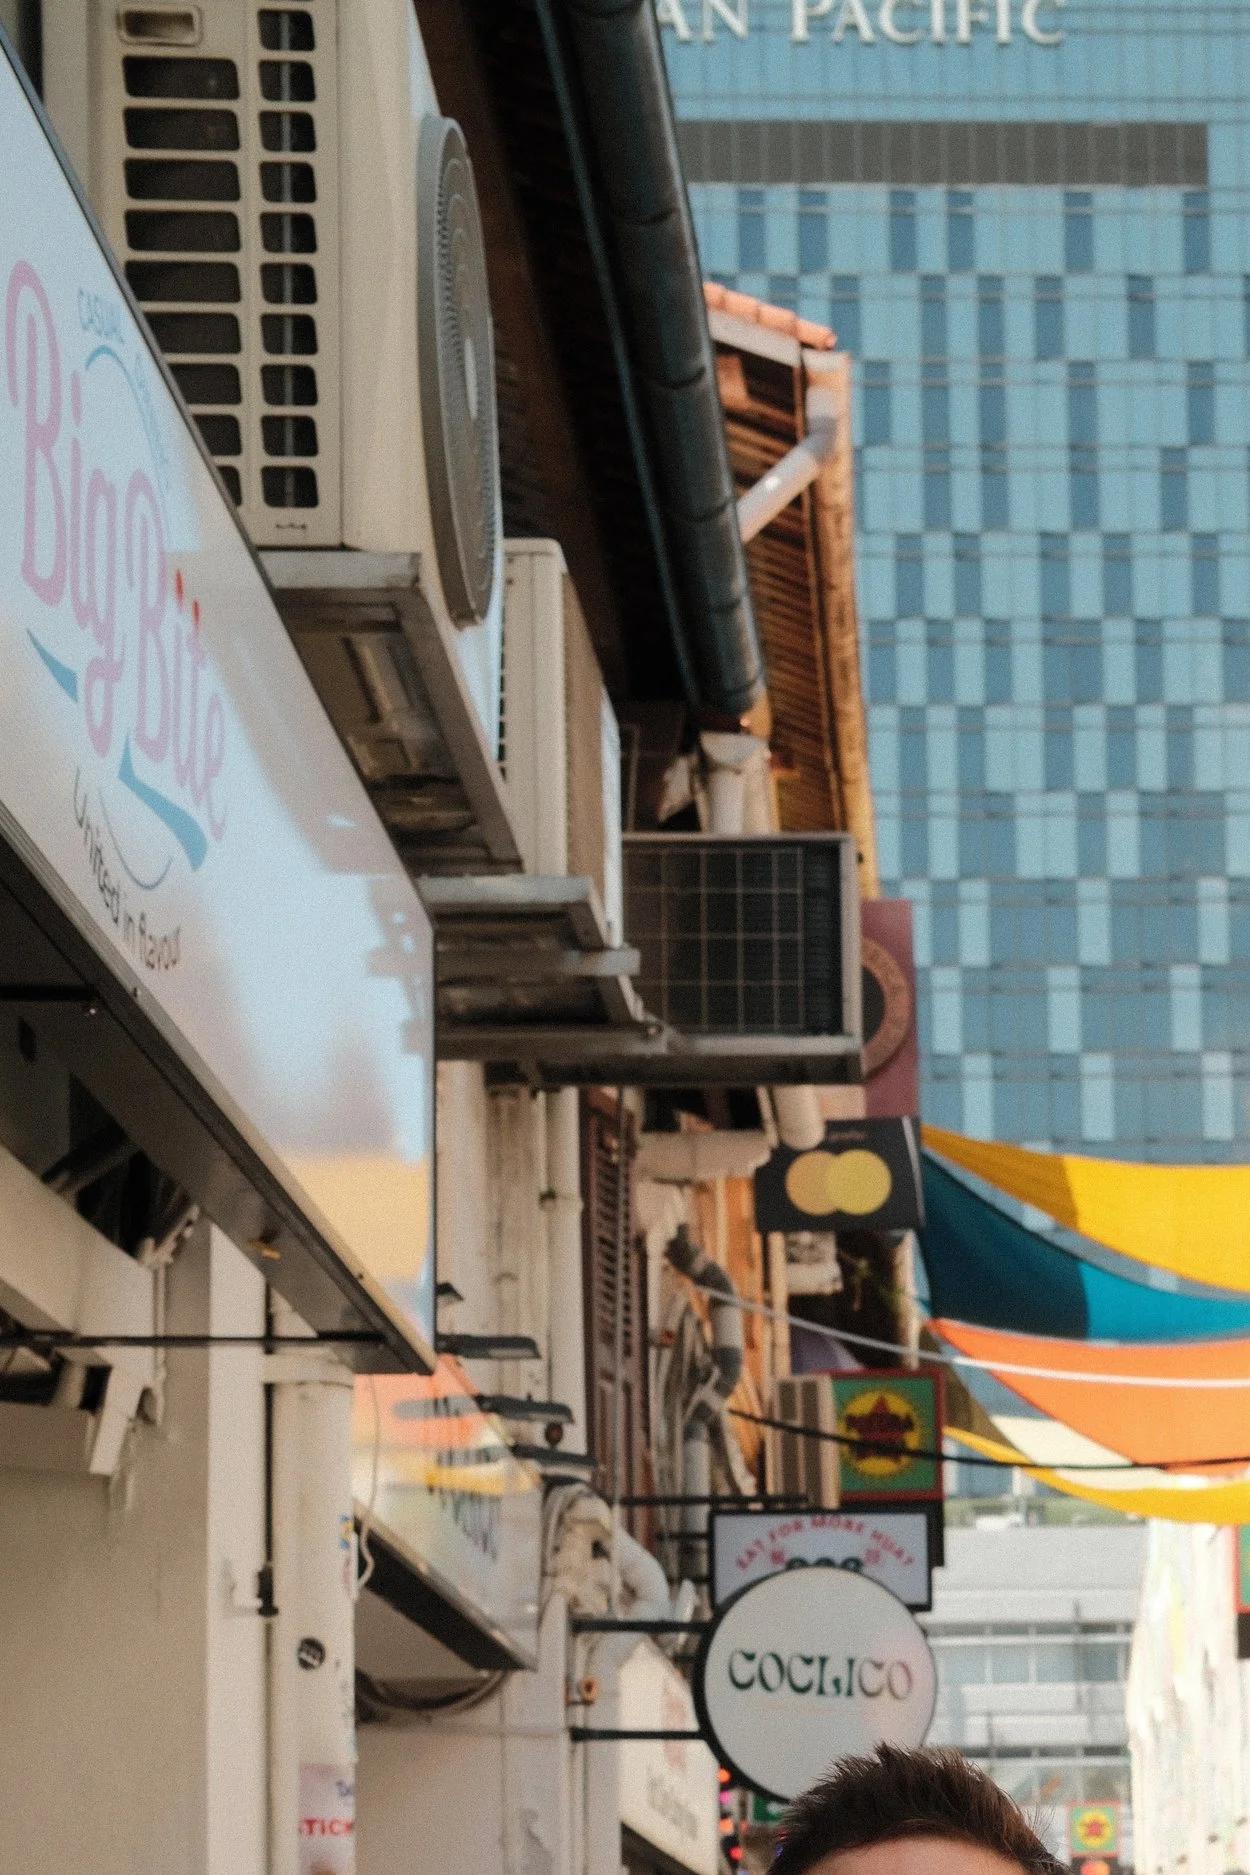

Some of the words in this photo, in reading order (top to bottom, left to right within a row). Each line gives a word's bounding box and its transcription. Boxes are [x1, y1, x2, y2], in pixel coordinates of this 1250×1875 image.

[791, 0, 1064, 45] PACIFIC
[5, 258, 128, 760] Big
[124, 468, 228, 843] Bite
[728, 1650, 913, 1700] COCLICO
